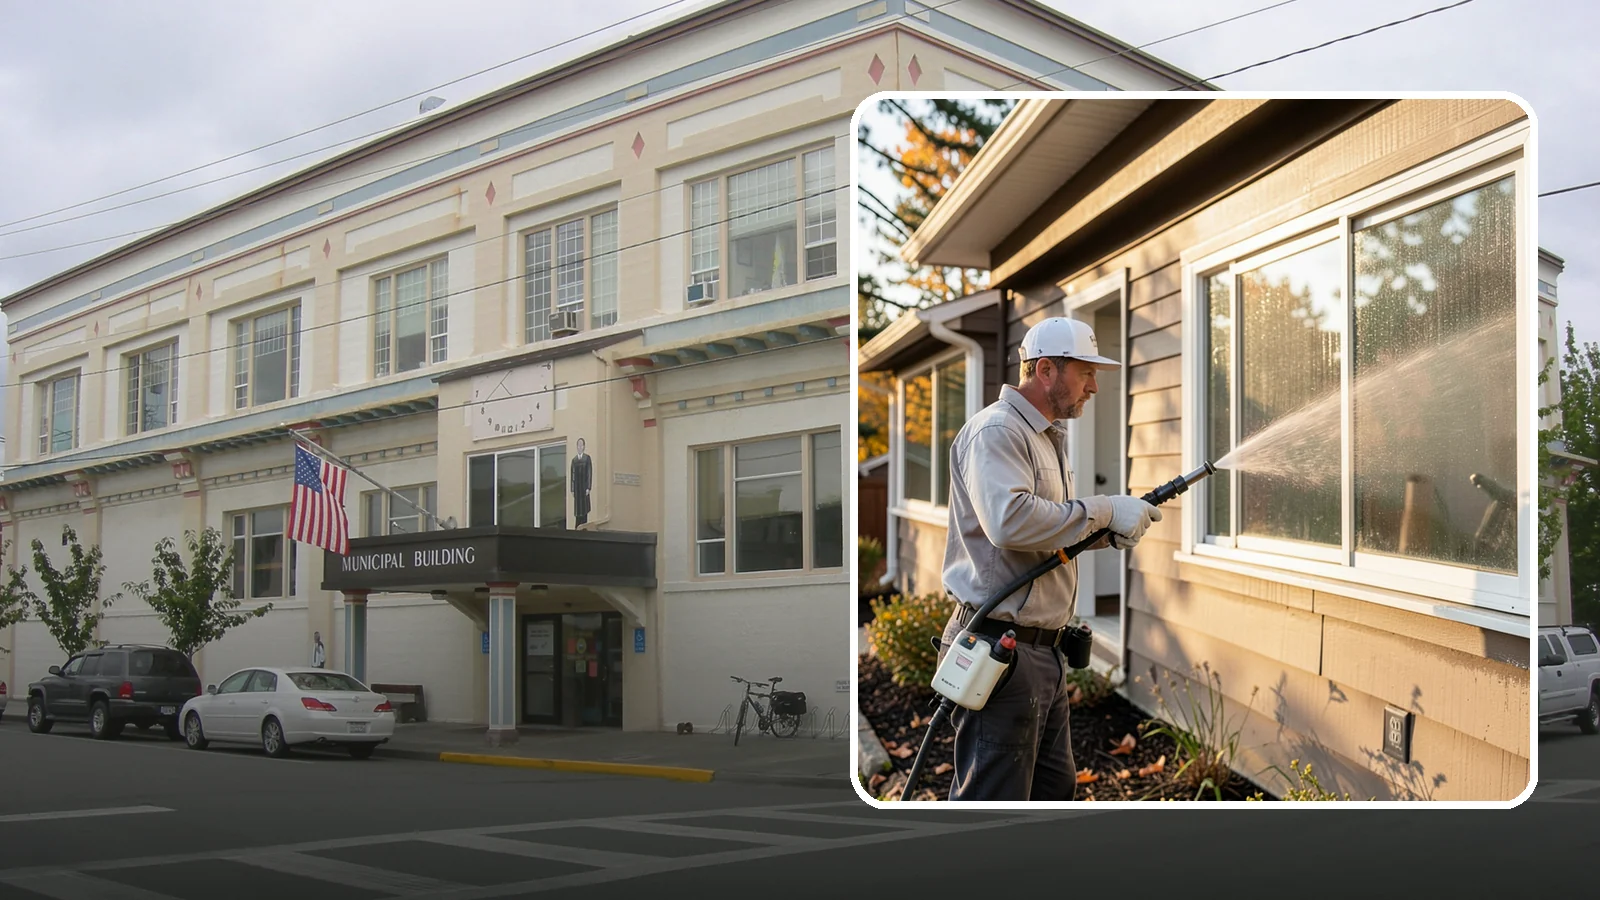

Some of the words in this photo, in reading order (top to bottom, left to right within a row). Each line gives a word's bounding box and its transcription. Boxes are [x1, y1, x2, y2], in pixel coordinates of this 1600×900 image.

[501, 426, 506, 434] 11
[507, 425, 513, 433] 12
[521, 420, 525, 428] 2
[529, 414, 533, 422] 3
[536, 402, 540, 410] 4
[342, 552, 405, 572] MUNICIPAL
[414, 546, 475, 567] BUILDING
